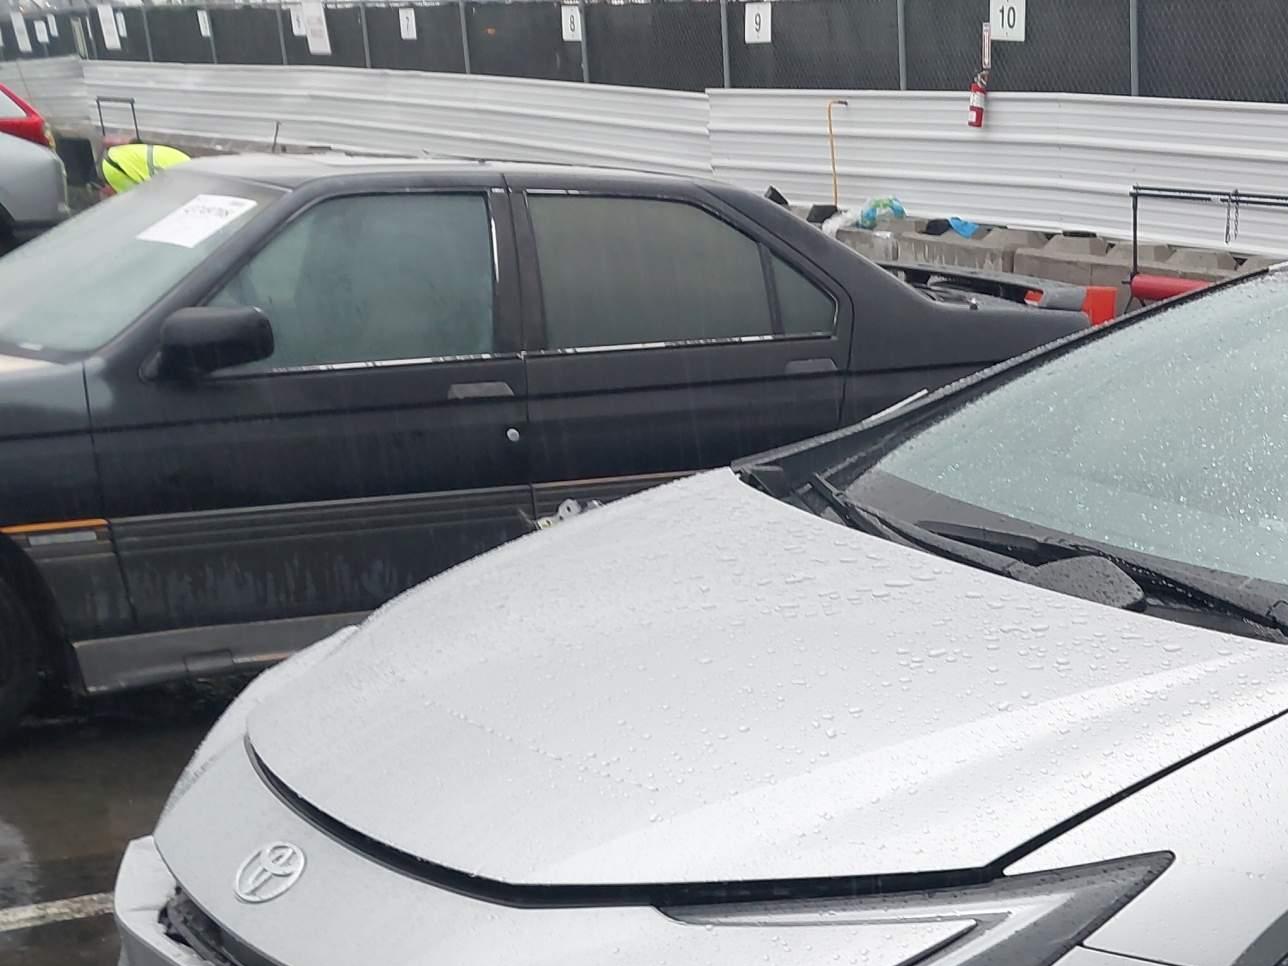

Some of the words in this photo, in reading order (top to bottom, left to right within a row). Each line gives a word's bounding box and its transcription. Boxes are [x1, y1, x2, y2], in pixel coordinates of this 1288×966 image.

[569, 14, 576, 33] 8
[754, 13, 762, 33] 9
[999, 6, 1016, 29] 10
